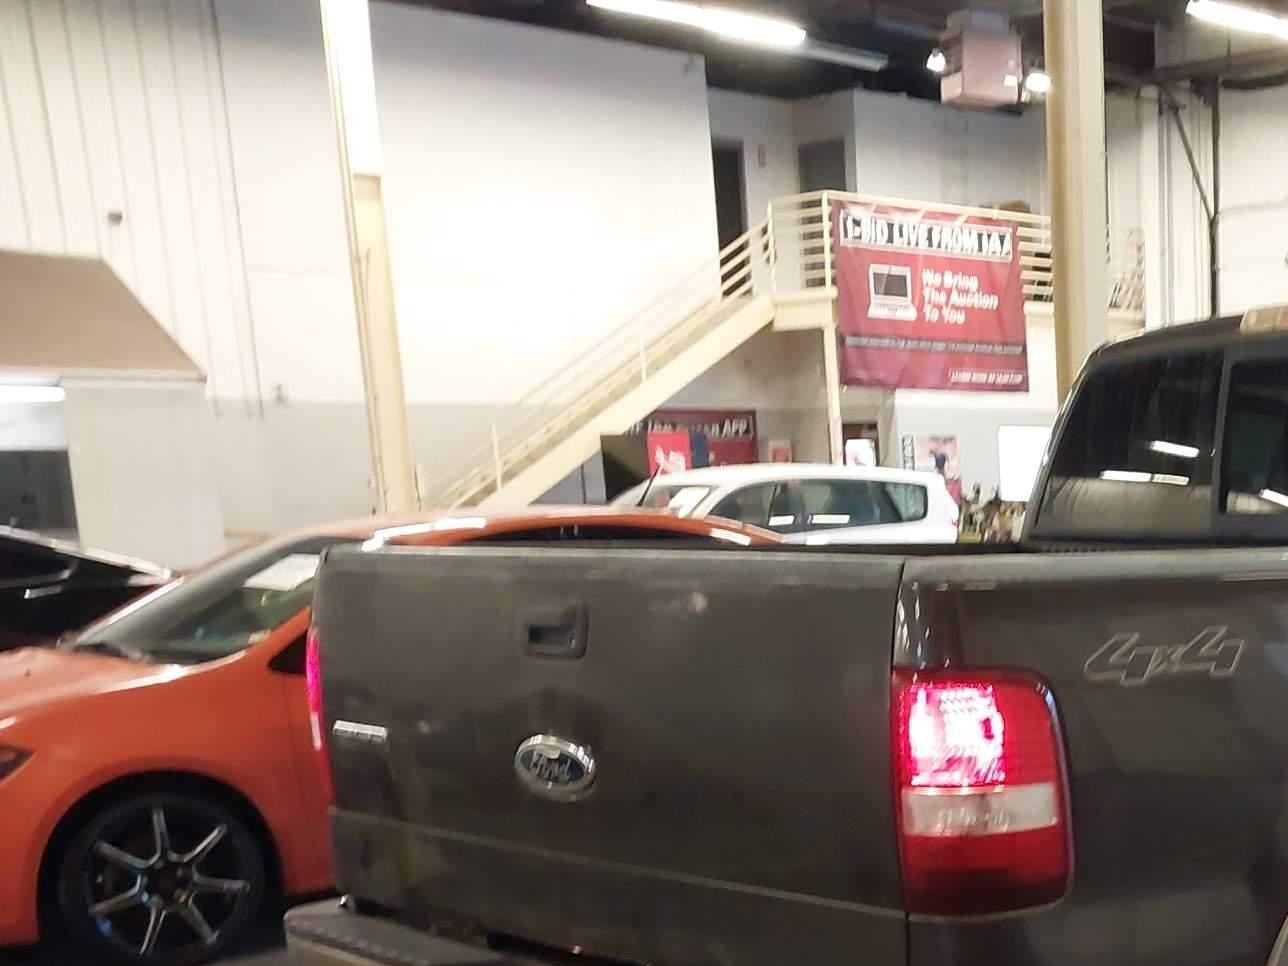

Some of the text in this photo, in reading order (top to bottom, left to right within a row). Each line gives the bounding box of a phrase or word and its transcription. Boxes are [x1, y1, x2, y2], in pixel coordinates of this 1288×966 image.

[893, 217, 929, 249] LIVE
[931, 224, 979, 254] FROM
[921, 267, 979, 293] We Bring
[922, 287, 999, 310] The Auction
[923, 303, 967, 325] To You
[721, 418, 748, 437] APP
[1083, 625, 1247, 687] 4x4
